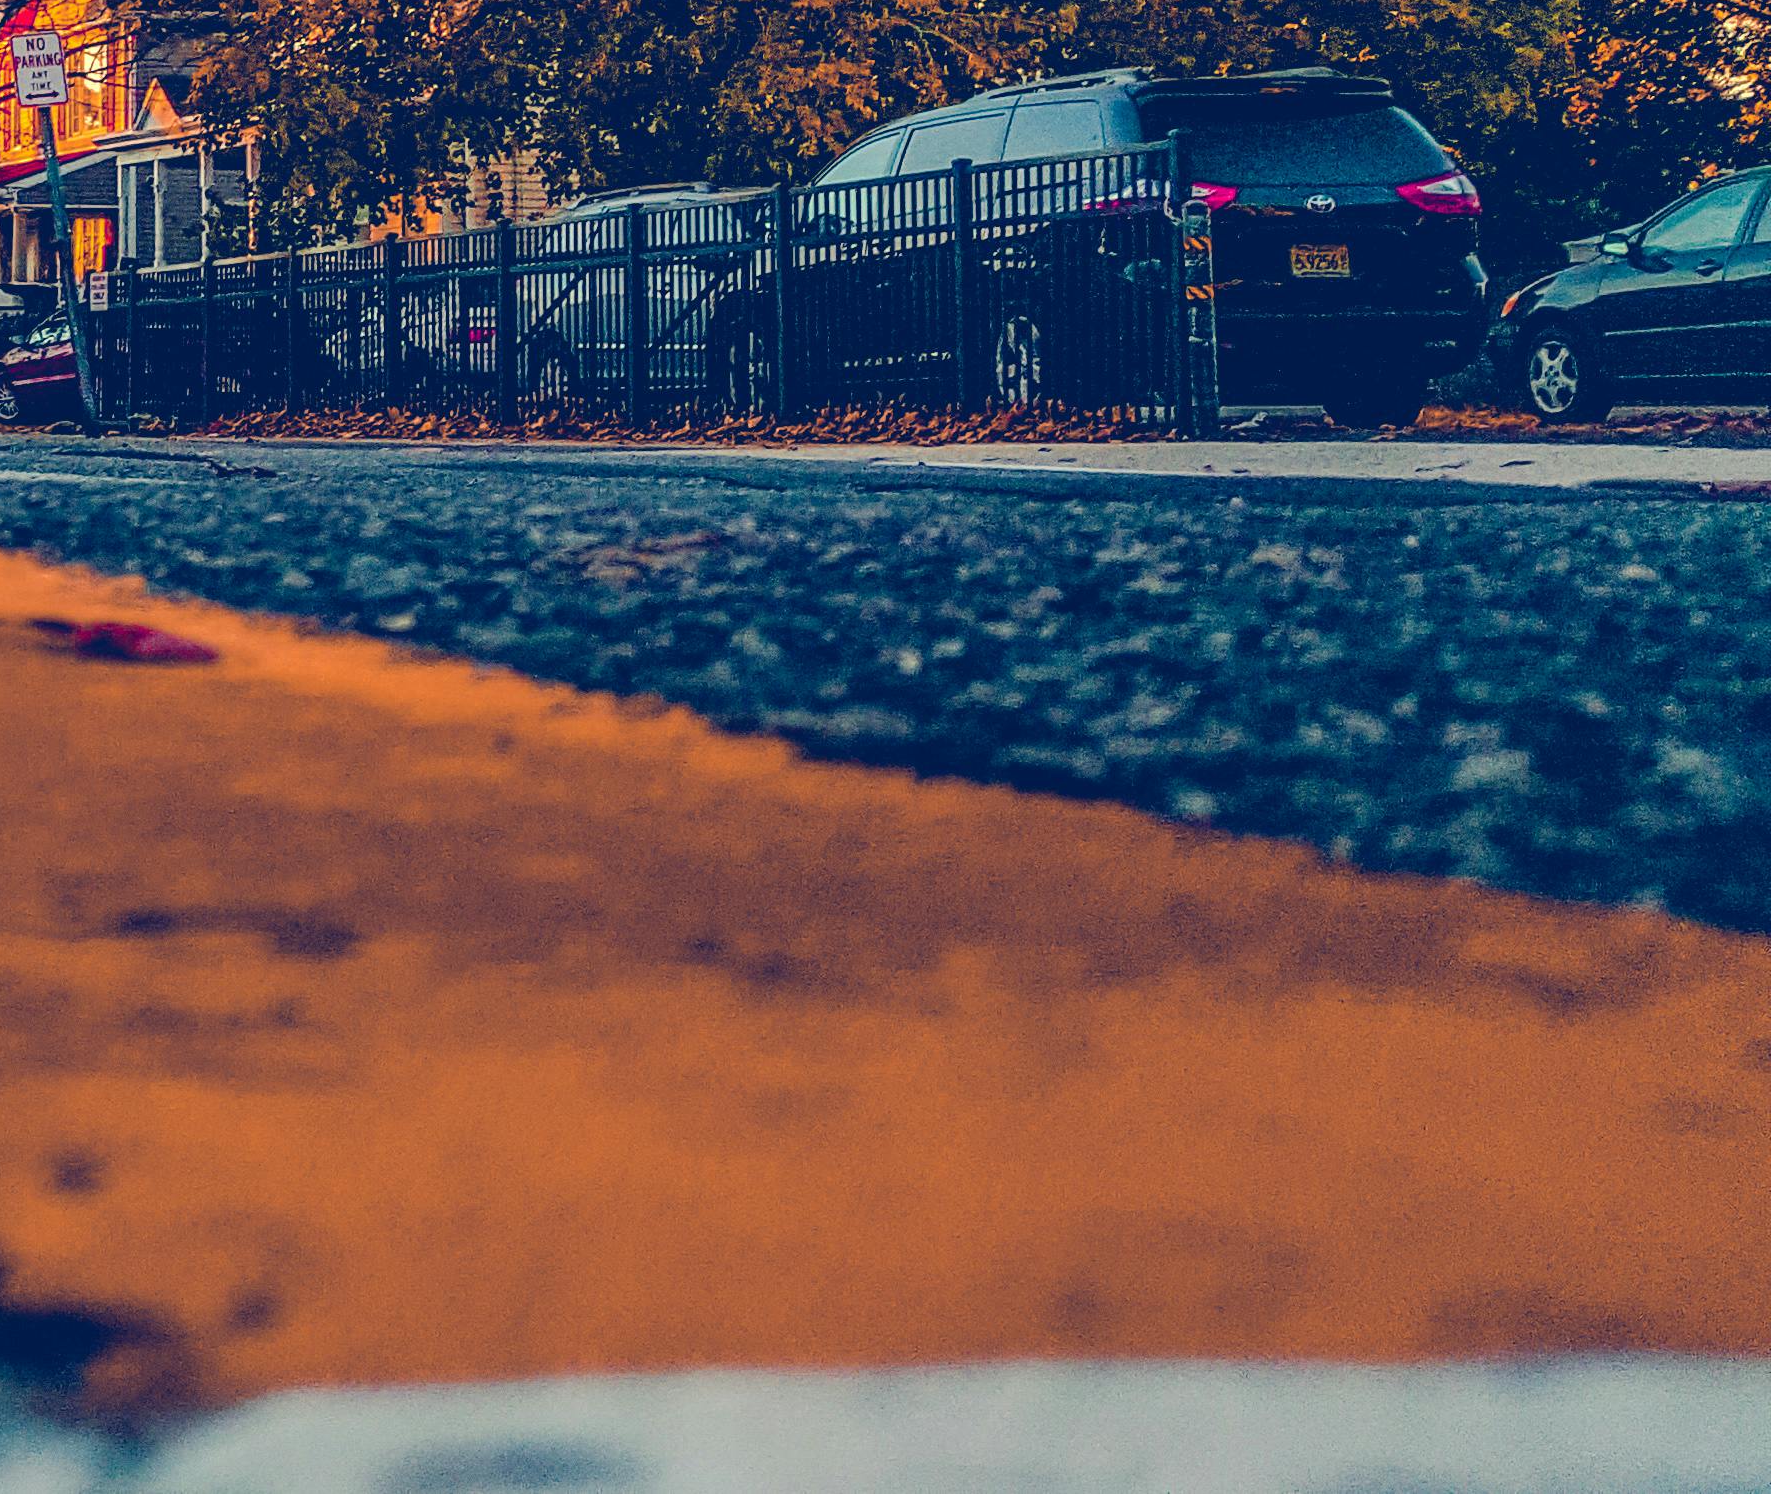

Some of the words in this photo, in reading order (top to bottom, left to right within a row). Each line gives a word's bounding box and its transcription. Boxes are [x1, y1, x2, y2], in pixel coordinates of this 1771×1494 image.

[26, 37, 45, 51] NO
[14, 52, 63, 69] PARKING
[31, 82, 51, 91] TIME
